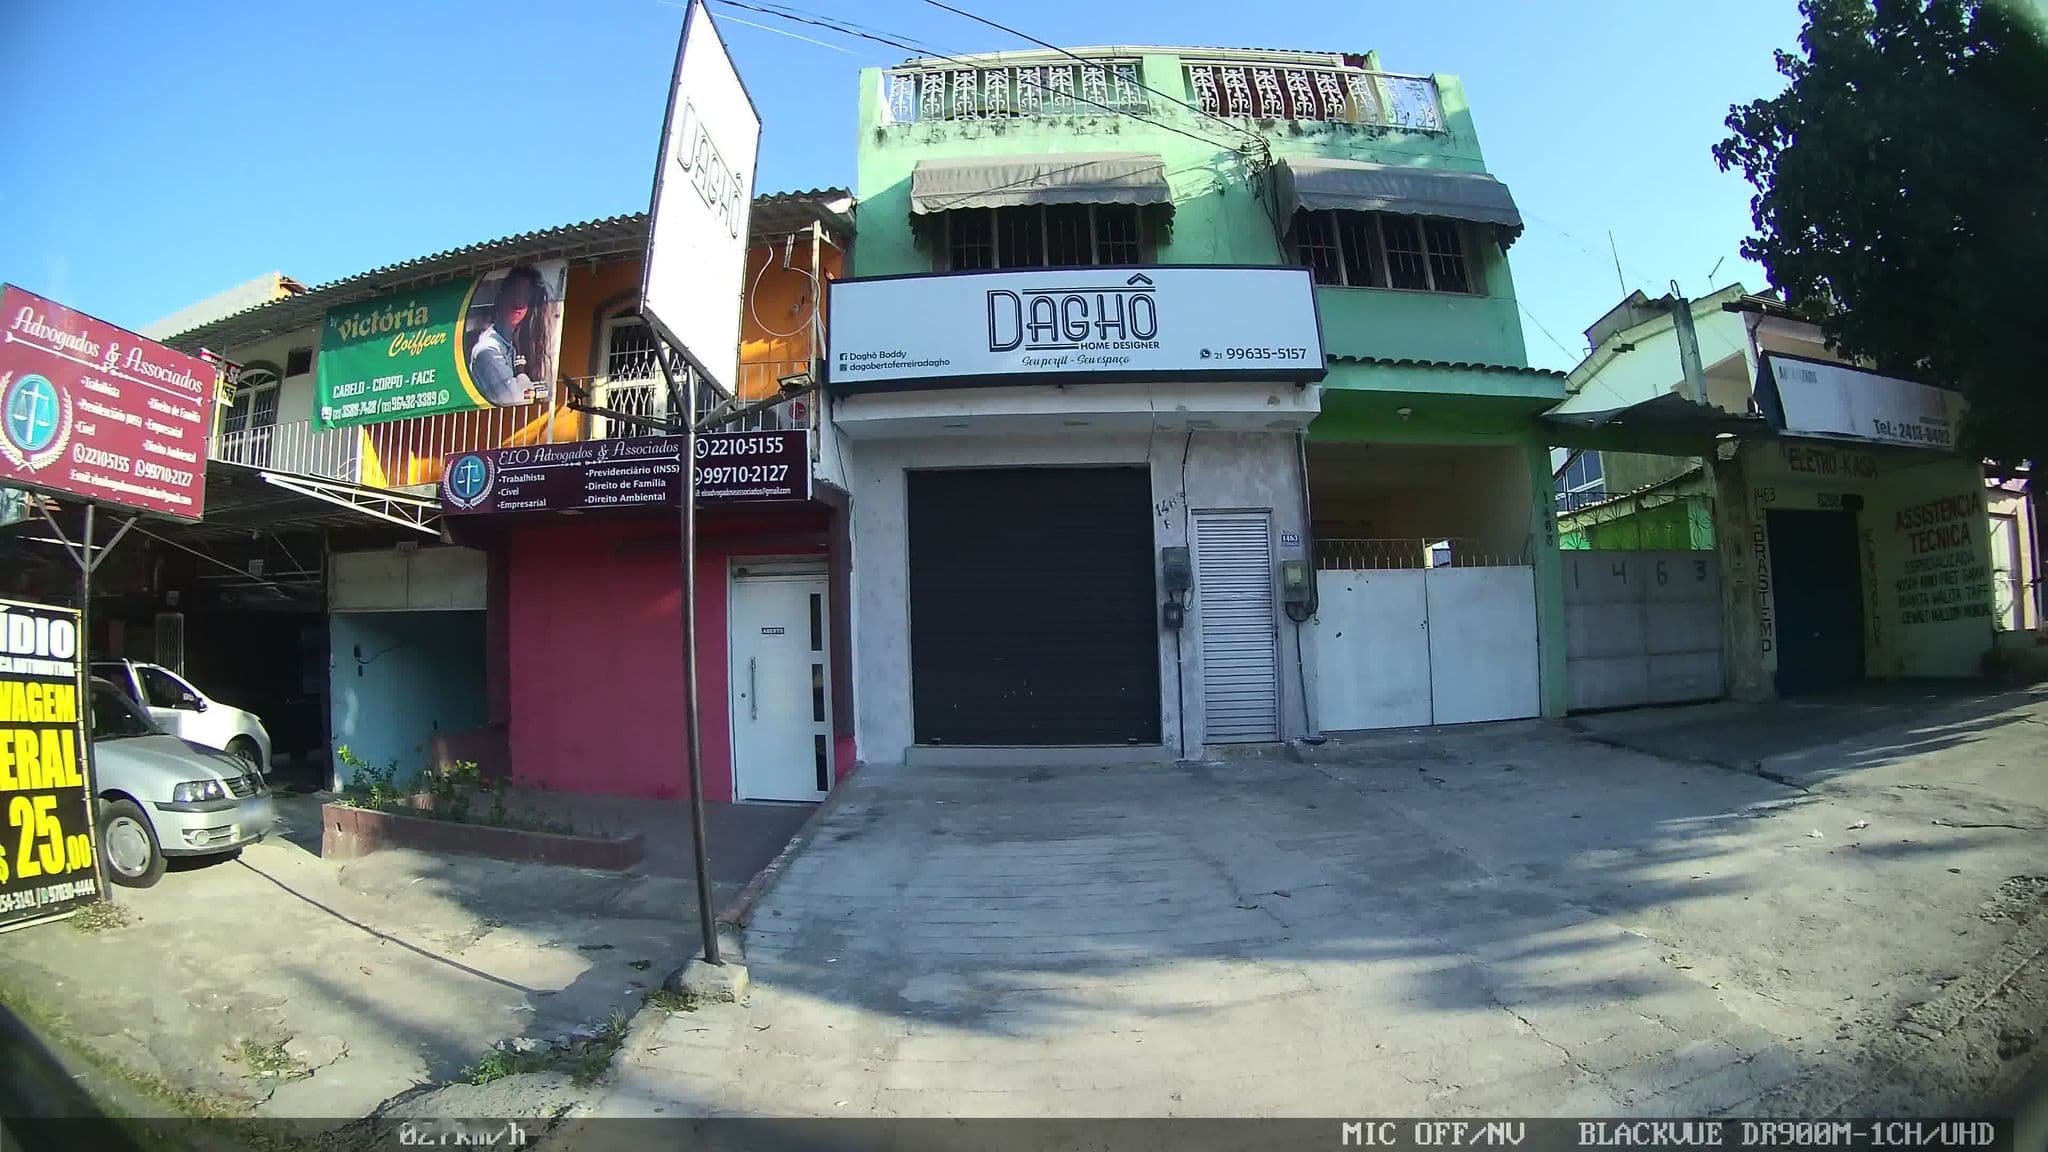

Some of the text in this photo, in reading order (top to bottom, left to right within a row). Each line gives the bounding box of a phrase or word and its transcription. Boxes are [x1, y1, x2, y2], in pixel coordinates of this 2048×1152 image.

[987, 273, 1158, 353] DAGHÔ
[388, 329, 447, 357] Coiffeur
[1081, 341, 1160, 350] HOME DESIGNER
[1226, 347, 1306, 360] 99635-5157
[411, 369, 436, 386] FACE
[532, 447, 593, 464] Advogados
[612, 440, 679, 457] Associados
[711, 437, 784, 456] 2210-5155
[501, 473, 546, 484] Trabalhista
[588, 467, 651, 478] Previdenciário
[704, 465, 788, 484] 99710-2127
[588, 481, 618, 492] Direito
[620, 481, 632, 490] de
[500, 499, 547, 511] Empresarial
[588, 492, 666, 505] Direito Ambiental
